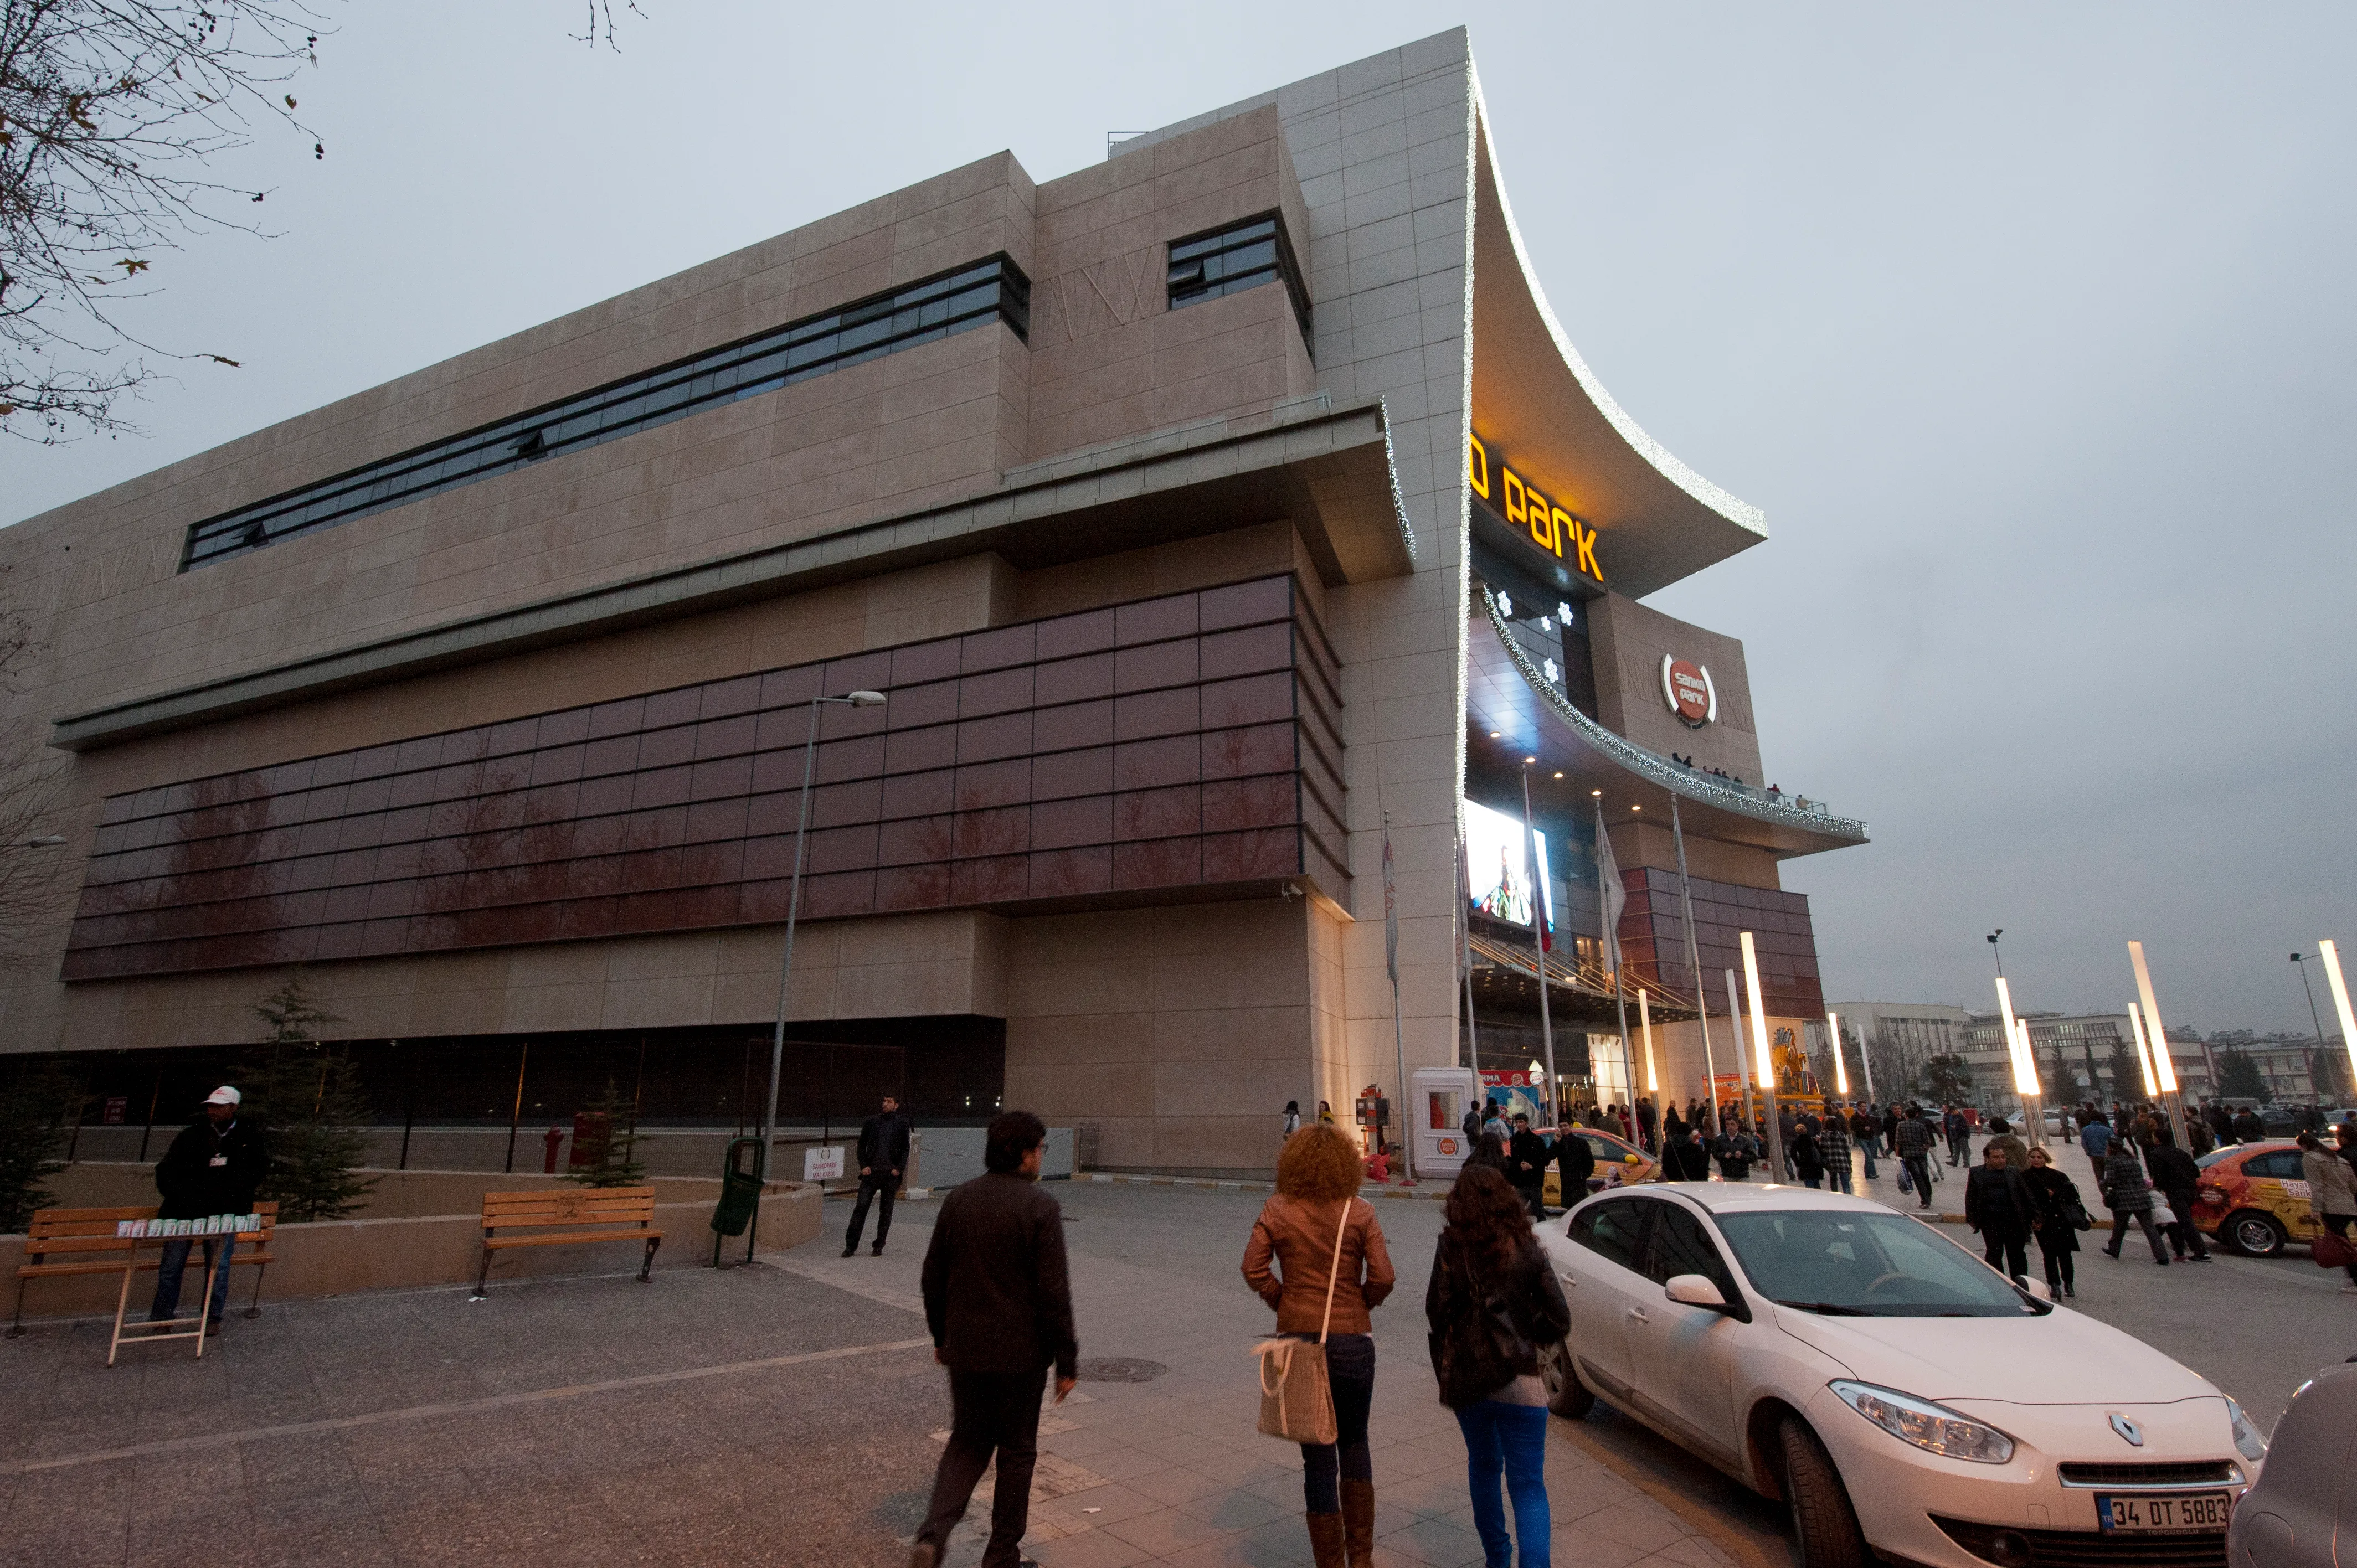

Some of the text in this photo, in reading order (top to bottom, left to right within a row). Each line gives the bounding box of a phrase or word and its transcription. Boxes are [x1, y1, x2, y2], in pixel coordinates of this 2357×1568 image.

[2282, 1180, 2308, 1189] Hayat
[2288, 1188, 2312, 1196] Sank
[2112, 1501, 2139, 1526] 34
[2181, 1498, 2227, 1524] 5883
